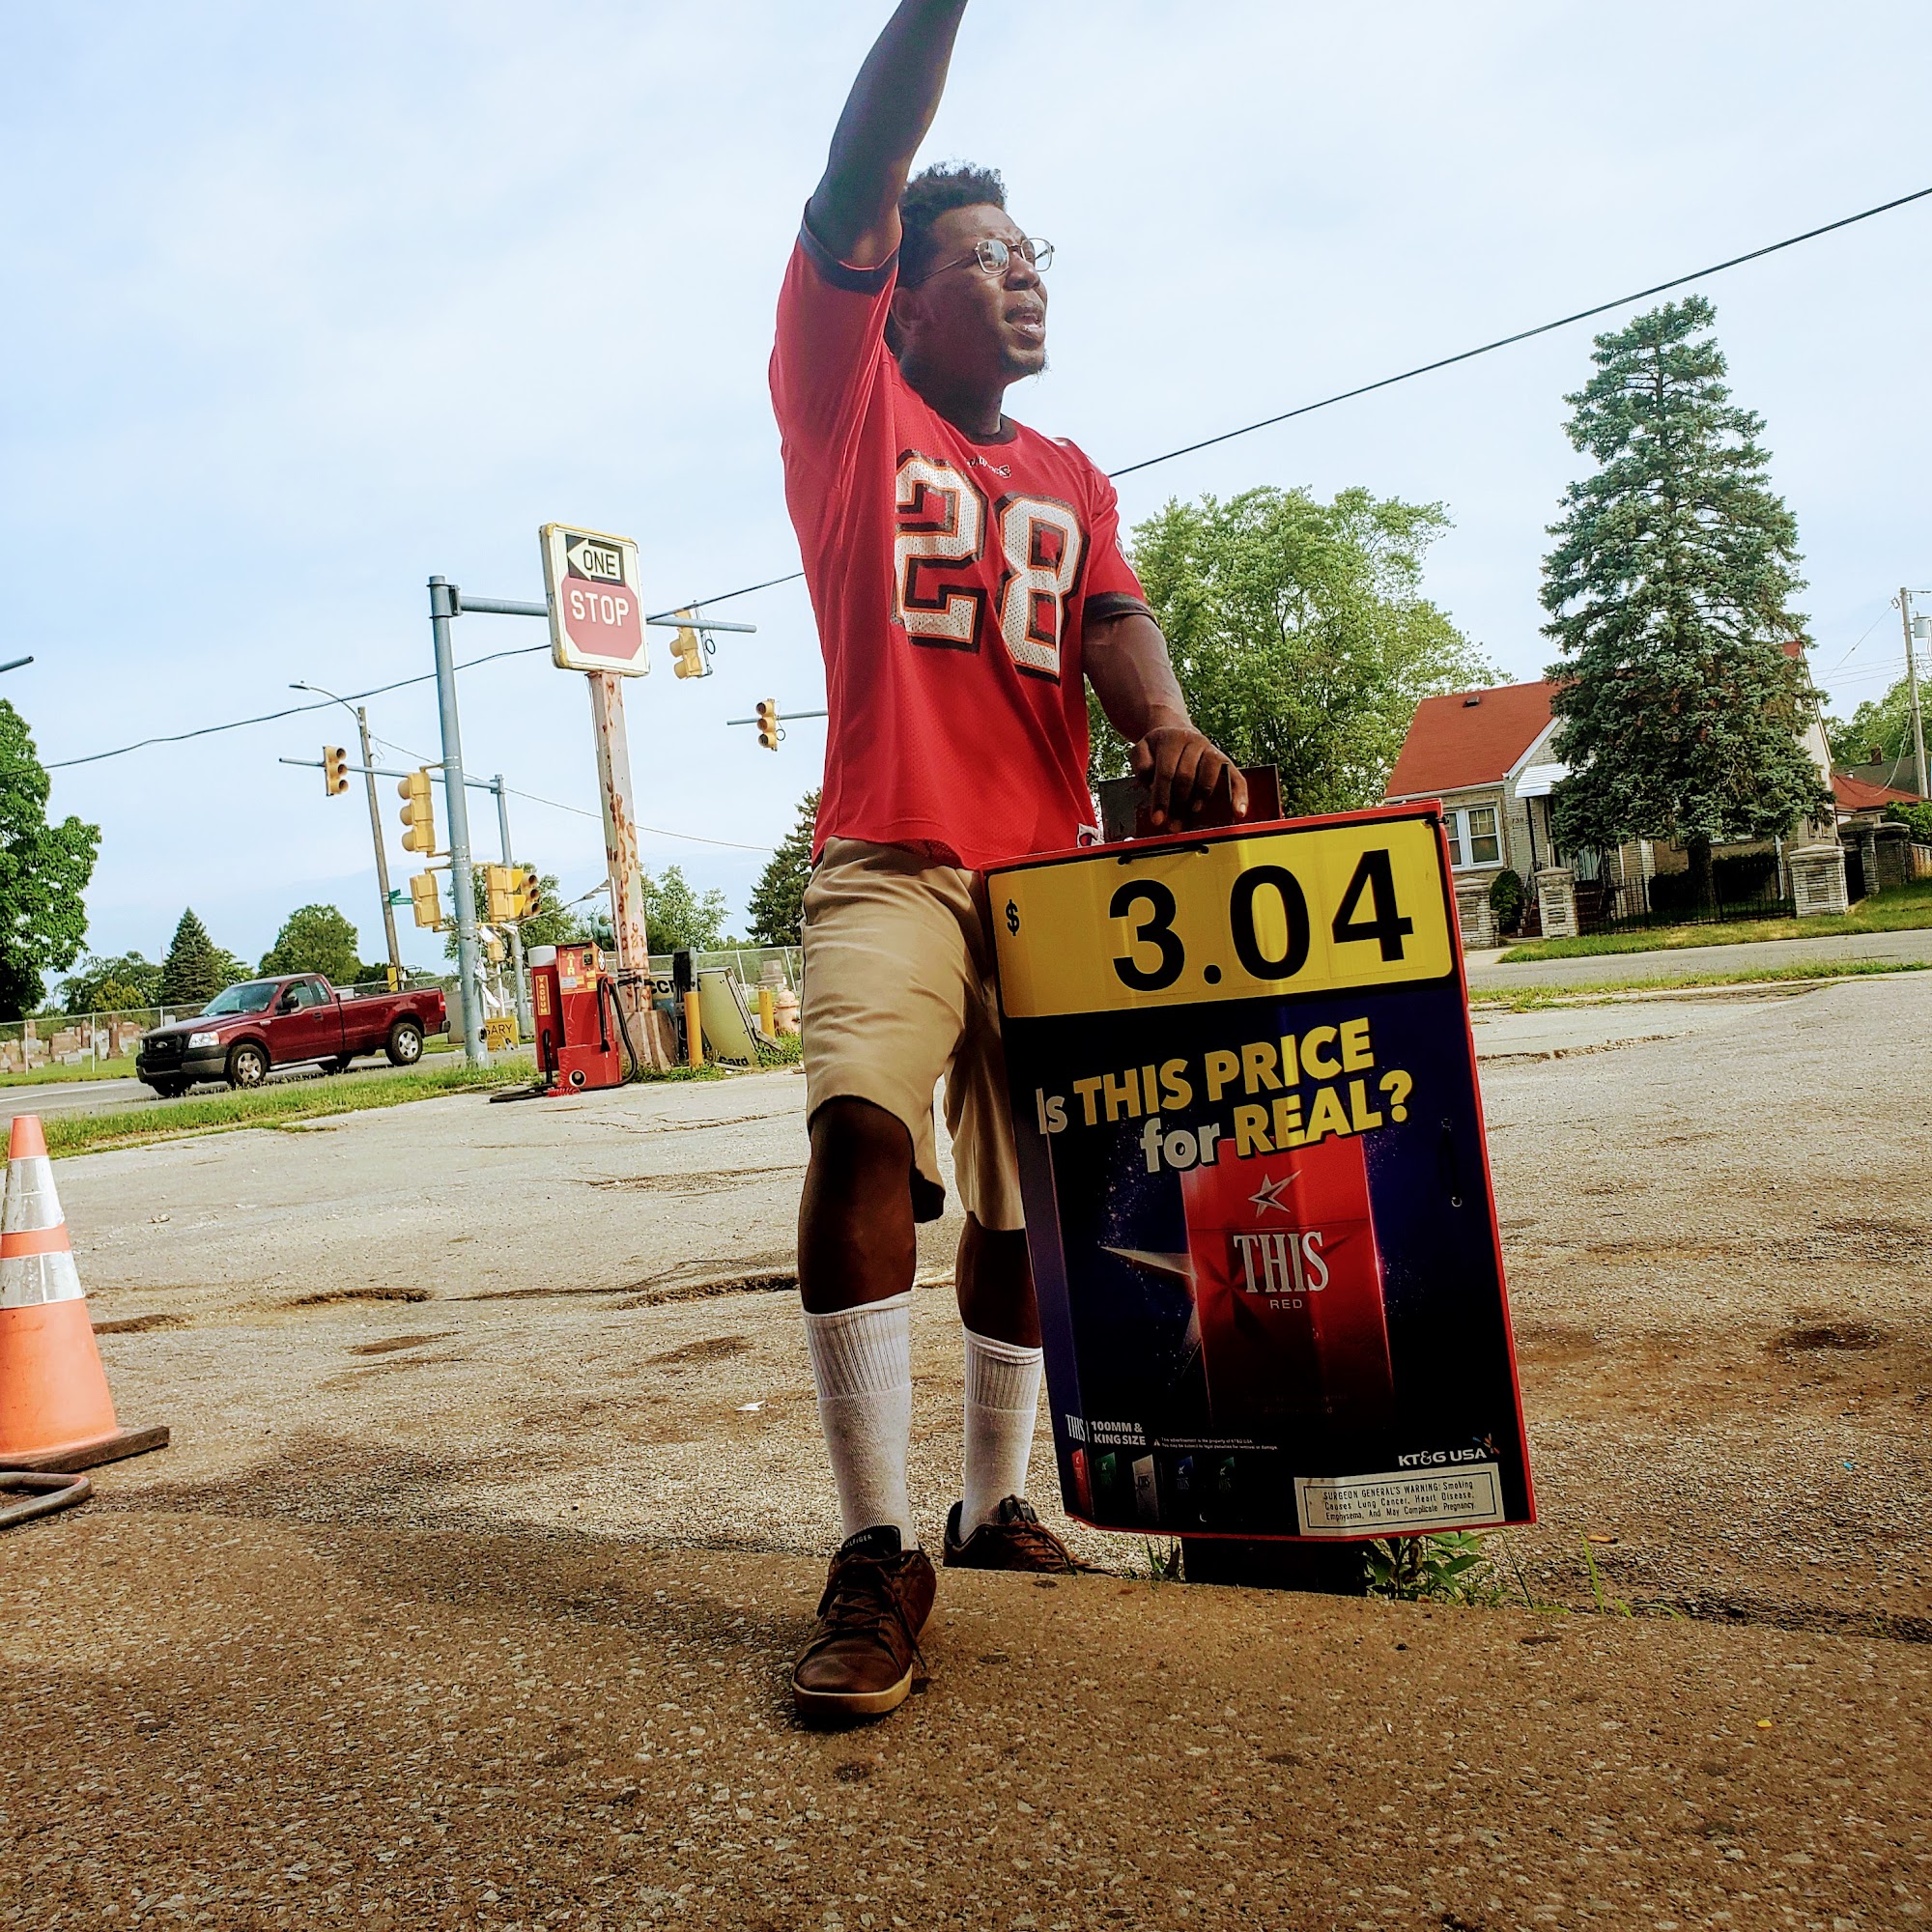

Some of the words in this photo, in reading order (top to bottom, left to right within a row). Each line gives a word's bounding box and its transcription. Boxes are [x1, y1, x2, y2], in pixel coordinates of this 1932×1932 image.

[583, 550, 616, 576] ONE
[892, 449, 1091, 687] 28
[570, 590, 629, 626] STOP
[1005, 898, 1020, 937] $
[1109, 848, 1414, 992] 3.04
[566, 952, 576, 976] AIR
[538, 977, 548, 1013] VACUUM
[1036, 1087, 1068, 1135] Is
[1073, 1058, 1193, 1126] THIS
[1205, 1016, 1375, 1101] PRICE
[1140, 1118, 1220, 1173] for
[1233, 1069, 1413, 1156] REAL?
[1233, 1231, 1329, 1293] THIS
[1269, 1299, 1303, 1309] RED
[1065, 1413, 1086, 1441] THIS
[1091, 1421, 1132, 1433] 100MM
[1134, 1422, 1144, 1433] &
[1398, 1450, 1447, 1466] KT&G
[1449, 1448, 1487, 1462] USA
[1323, 1490, 1358, 1500] SURGEON
[1361, 1486, 1401, 1497] GENERAL'S
[1404, 1483, 1441, 1494] WARNING:
[1443, 1481, 1473, 1491] Smoking
[1324, 1500, 1352, 1510] Causes
[1357, 1499, 1377, 1509] Lung
[1415, 1494, 1436, 1503] Heart
[1368, 1508, 1381, 1518] And
[1386, 1507, 1400, 1517] May
[1404, 1504, 1438, 1515] Complicate
